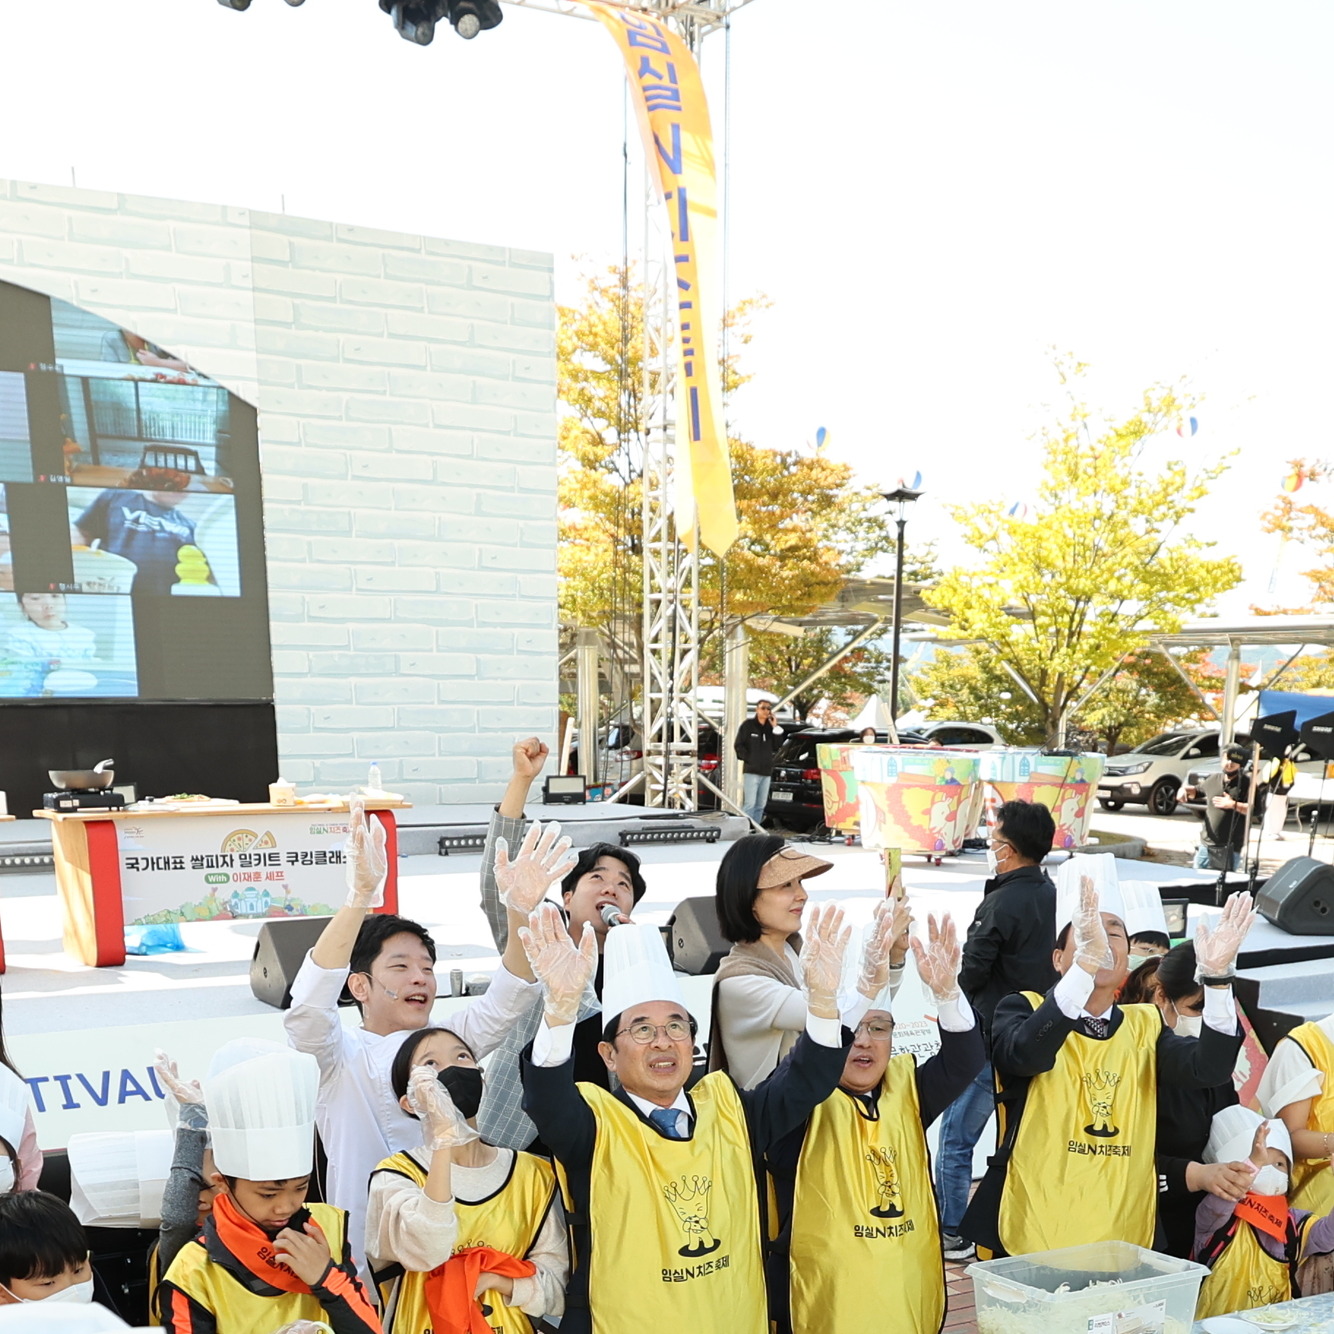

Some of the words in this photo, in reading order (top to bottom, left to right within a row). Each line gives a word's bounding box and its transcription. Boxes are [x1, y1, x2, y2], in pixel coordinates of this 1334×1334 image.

[125, 856, 185, 872] 국가대표
[190, 853, 234, 870] 쌀피자
[238, 851, 281, 868] 밀키트
[207, 874, 227, 883] With
[232, 871, 262, 883] 이재훈
